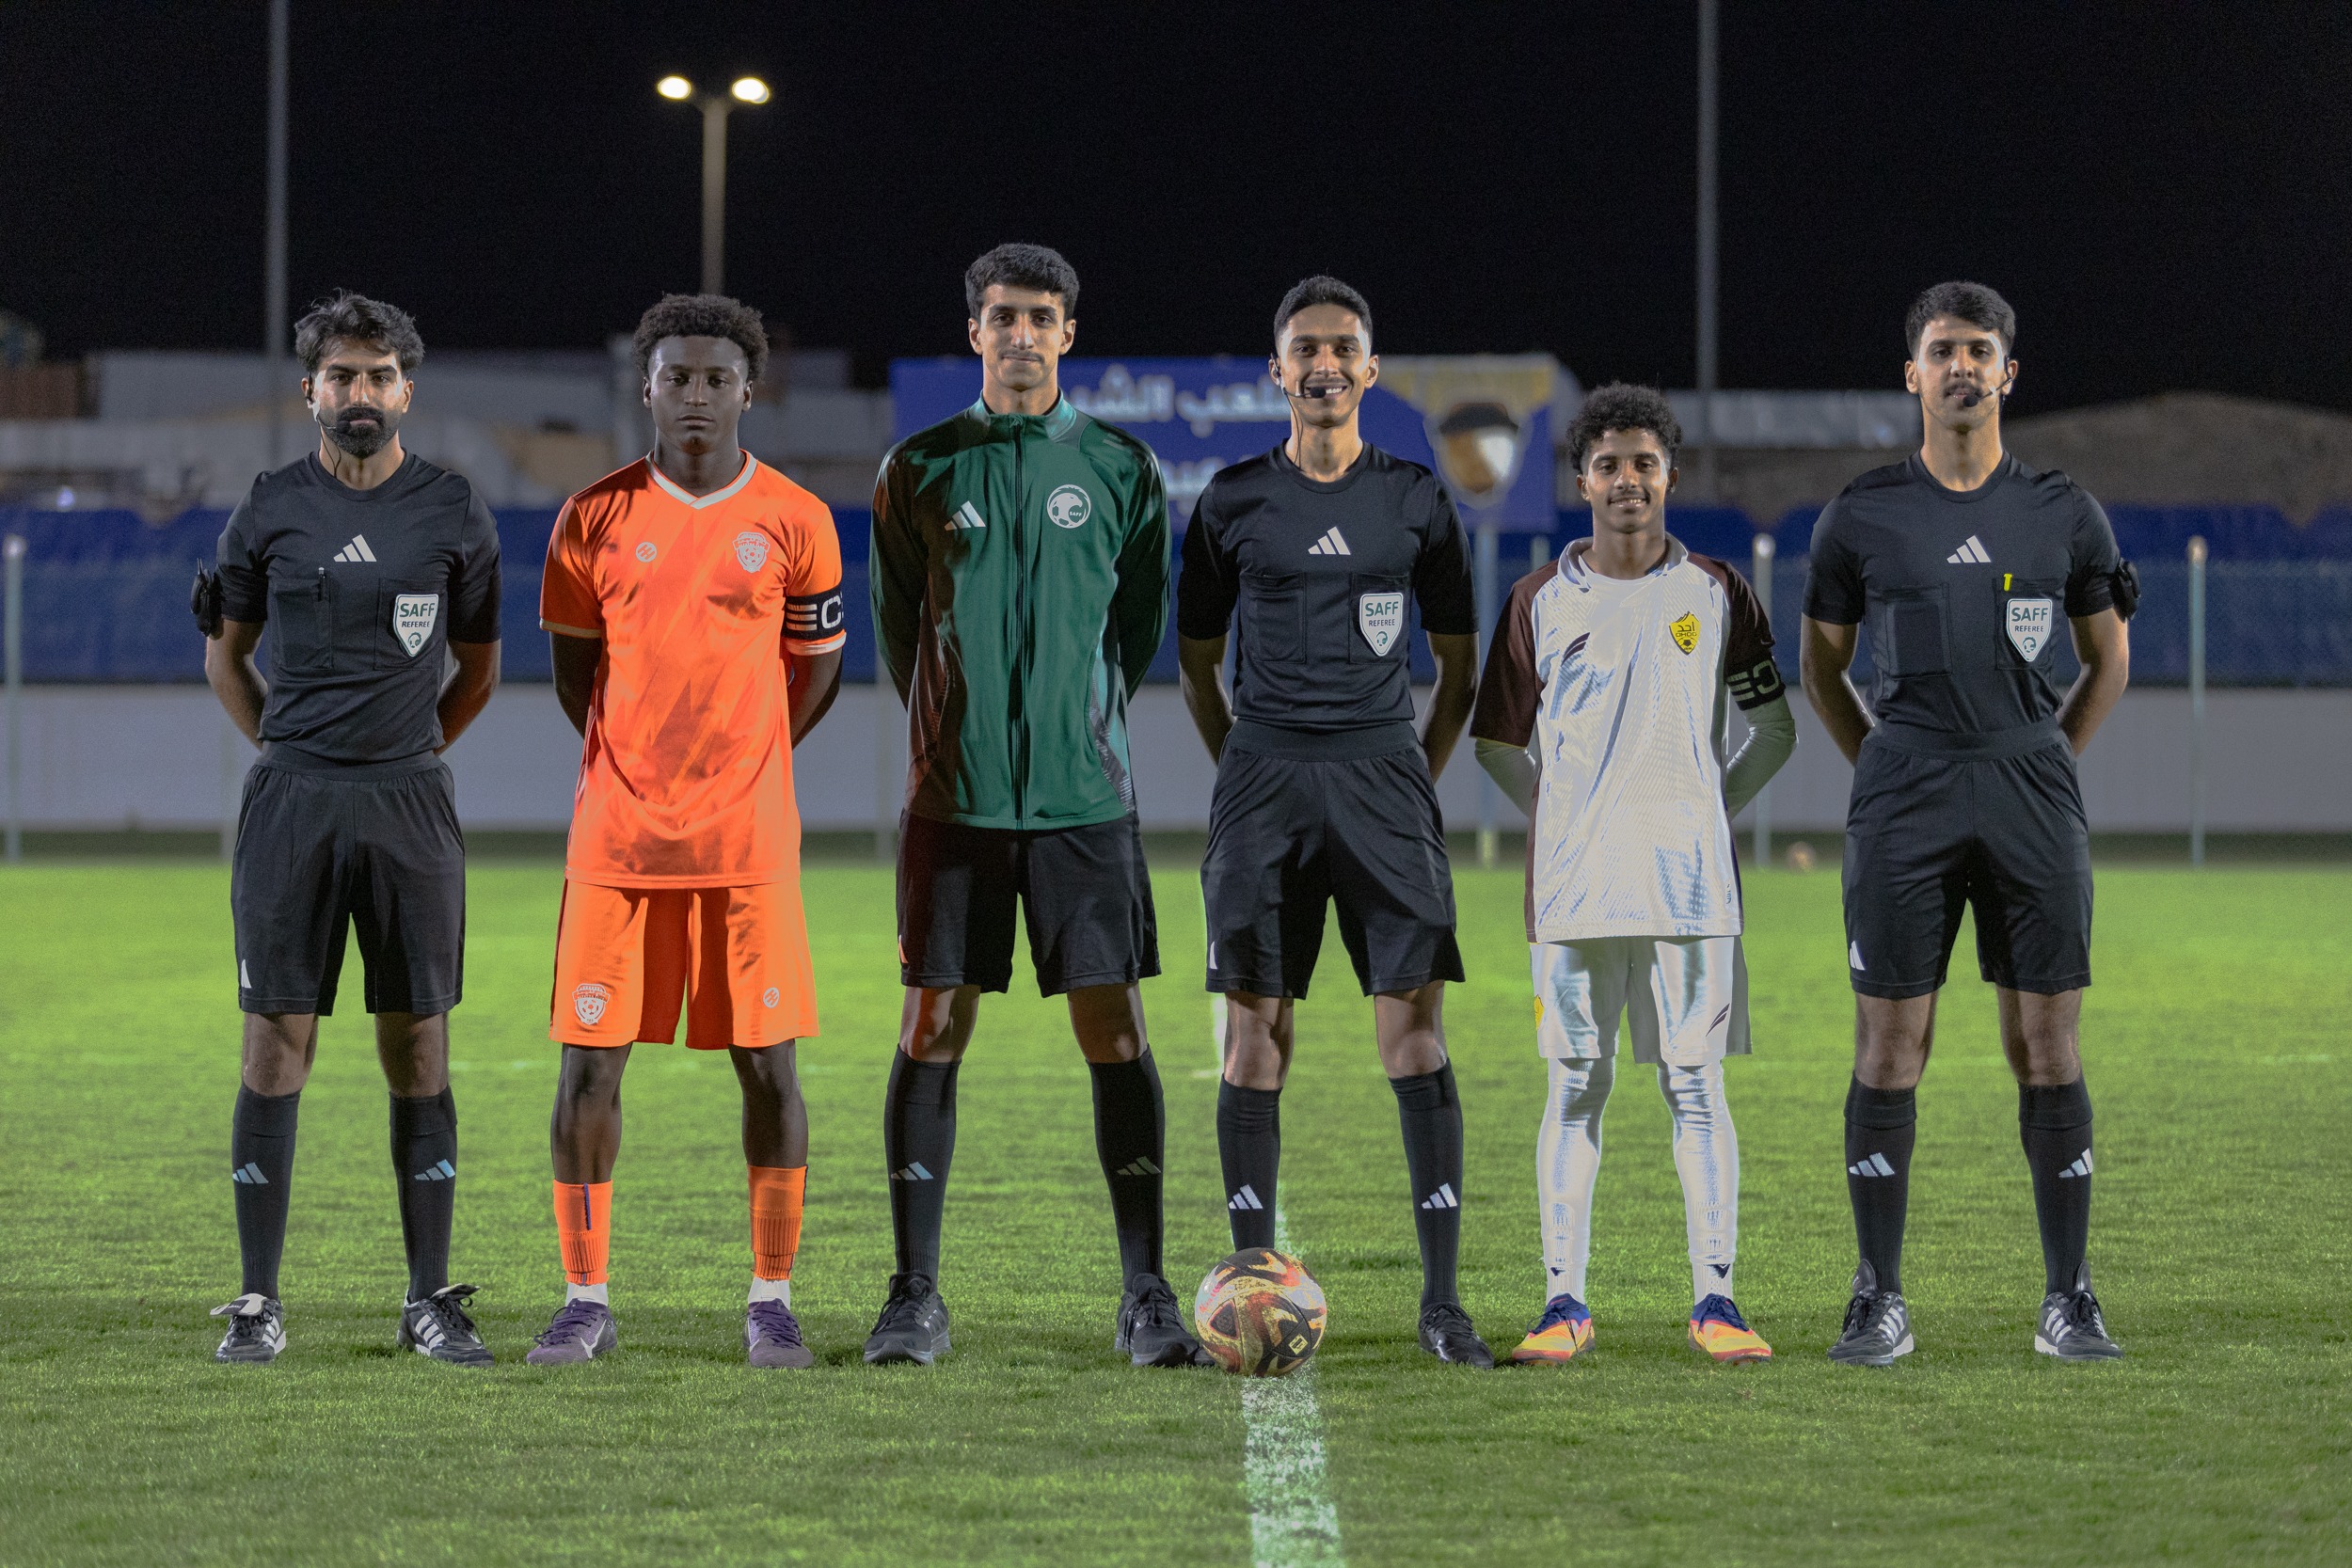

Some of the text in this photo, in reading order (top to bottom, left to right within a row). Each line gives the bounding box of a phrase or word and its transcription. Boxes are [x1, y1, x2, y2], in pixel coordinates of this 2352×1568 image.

[399, 602, 436, 618] SAFF
[1364, 601, 1399, 617] SAFF
[2010, 607, 2049, 622] SAFF
[1368, 619, 1395, 627] REFEREE
